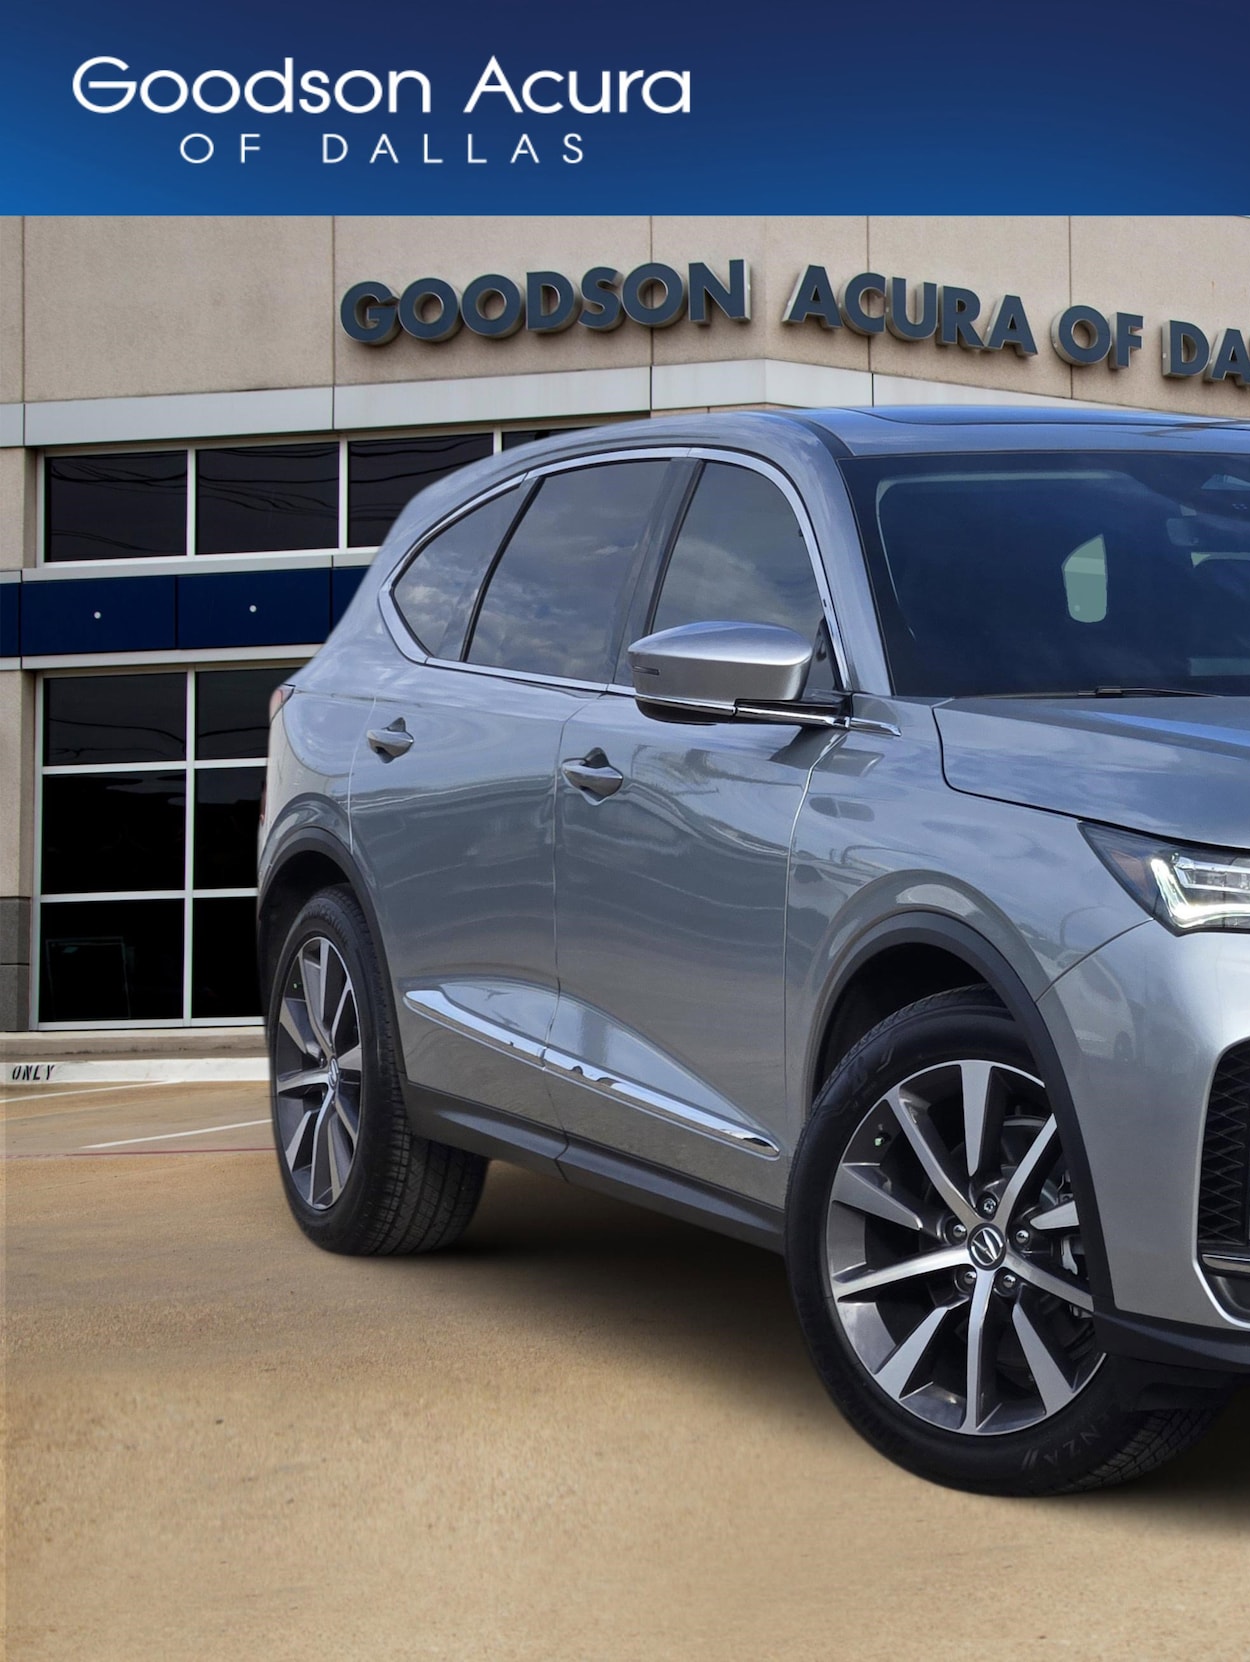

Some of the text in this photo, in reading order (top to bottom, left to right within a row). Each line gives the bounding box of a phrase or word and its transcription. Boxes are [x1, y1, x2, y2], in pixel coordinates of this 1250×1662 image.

[340, 259, 751, 346] GOODSON
[782, 264, 1038, 357] ACURA
[1051, 305, 1144, 369] OF
[12, 1064, 55, 1081] ONLY
